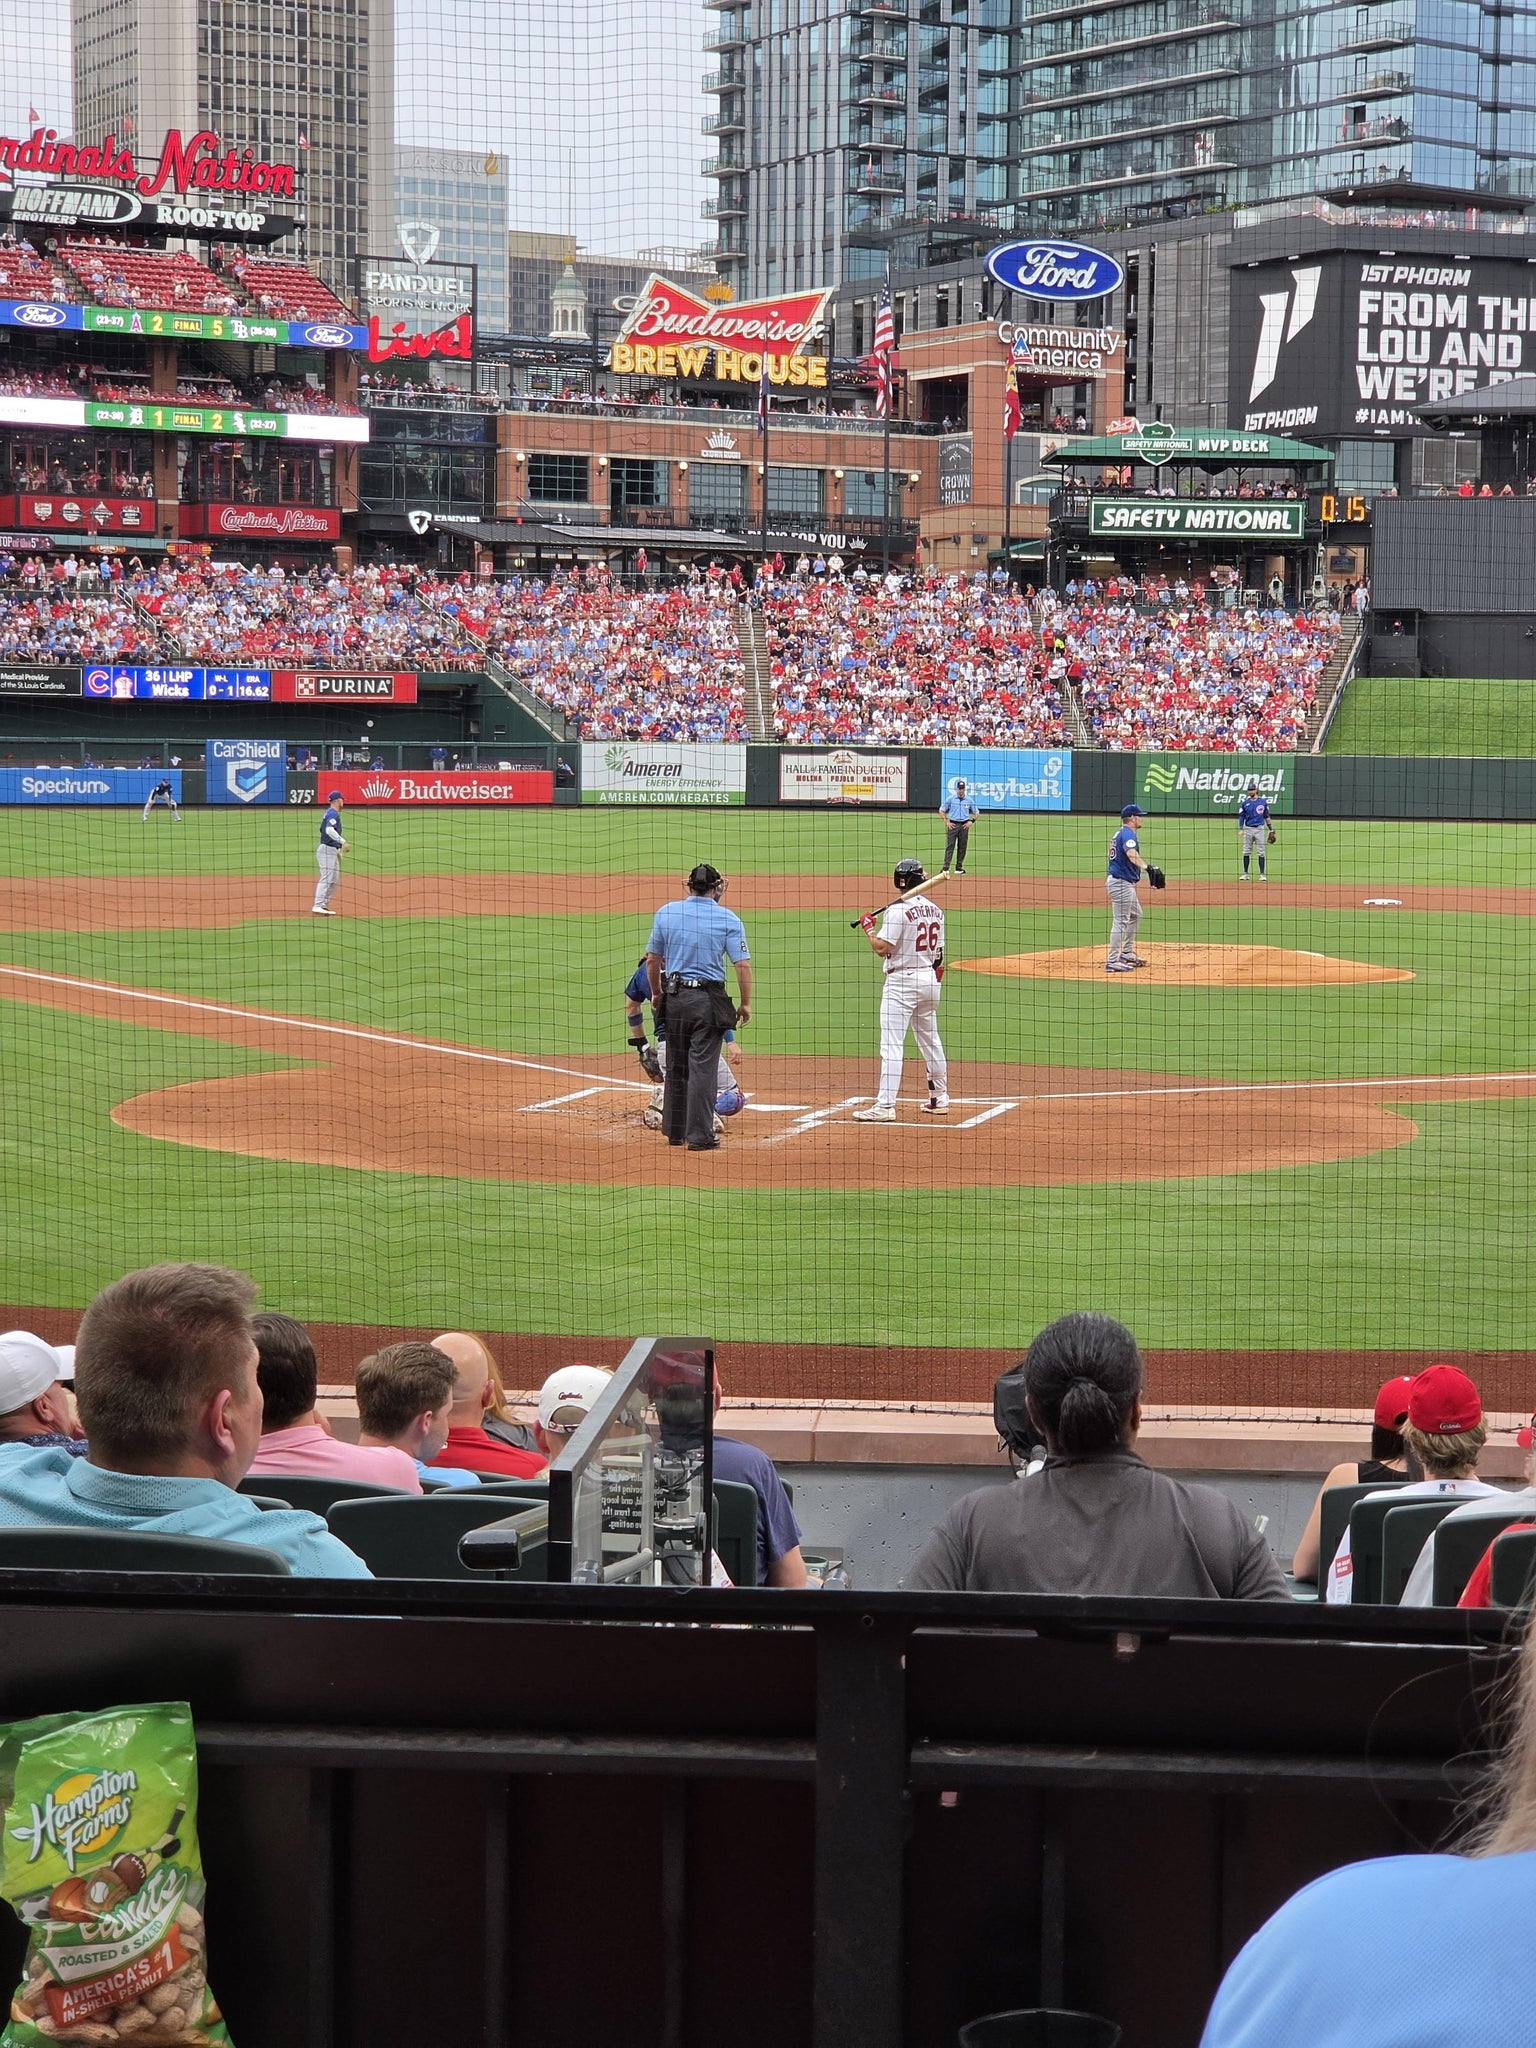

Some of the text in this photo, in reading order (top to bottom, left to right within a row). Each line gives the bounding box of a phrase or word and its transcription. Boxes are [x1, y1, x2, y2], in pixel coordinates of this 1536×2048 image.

[138, 129, 295, 197] Nation
[12, 187, 120, 218] HOFFMANN
[12, 211, 78, 225] BROTHERS
[156, 205, 266, 231] ROOFTOP
[1017, 246, 1098, 289] Ford
[1360, 264, 1471, 287] 1ST PHORM
[365, 271, 472, 297] FANDUEL
[22, 304, 57, 322] Ford
[367, 296, 472, 313] SPORTS NETWORK
[1358, 290, 1468, 328] FROM
[152, 315, 163, 332] 2
[174, 320, 200, 331] FINAL
[213, 320, 223, 336] 5
[612, 294, 826, 343] Budweiser
[312, 326, 345, 344] Ford
[368, 314, 472, 363] Live!
[998, 320, 1120, 355] Community
[1358, 328, 1522, 368] LOU AND
[610, 342, 828, 387] BREW HOUSE
[154, 410, 163, 427] 1
[174, 414, 200, 425] FINAL
[213, 413, 223, 430] 2
[1244, 406, 1318, 431] 1ST PHORM
[1126, 440, 1189, 449] SAFETY NATIONAL
[1197, 438, 1270, 453] MVP DECK
[940, 473, 971, 490] CROWN
[944, 490, 966, 505] HALL
[220, 507, 329, 533] Cardinals Nation
[1101, 508, 1292, 531] SAFETY NATIONAL
[0, 672, 50, 682] Medical Provider
[40, 682, 66, 691] Cardinals
[145, 671, 193, 683] 36 LHP
[246, 675, 261, 684] ERA
[319, 678, 388, 694] PURINA
[152, 684, 189, 697] Wicks
[239, 686, 269, 697] 16.62
[214, 742, 280, 758] CarShield
[623, 760, 682, 777] Ameren
[785, 765, 811, 774] HALL
[818, 765, 843, 775] FAME
[845, 765, 903, 776] INDUCTION
[22, 777, 104, 797] Spectrum
[398, 779, 512, 800] Budweiser
[645, 779, 723, 788] ENERGY EFFICIENCY
[1176, 767, 1284, 792] National
[289, 789, 315, 804] 375'
[600, 792, 729, 803] AMEREN.COM/REBATES
[1213, 793, 1234, 804] Car
[915, 921, 941, 952] 26
[11, 1769, 137, 1863] Hampton
[59, 1797, 131, 1871] Farms
[42, 1868, 187, 1946] Peanuts
[58, 1920, 163, 1968] ROASTED & SALTED
[62, 1958, 151, 2008] AMERICA'S
[63, 1967, 163, 2024] IN-SHELL PEANUT
